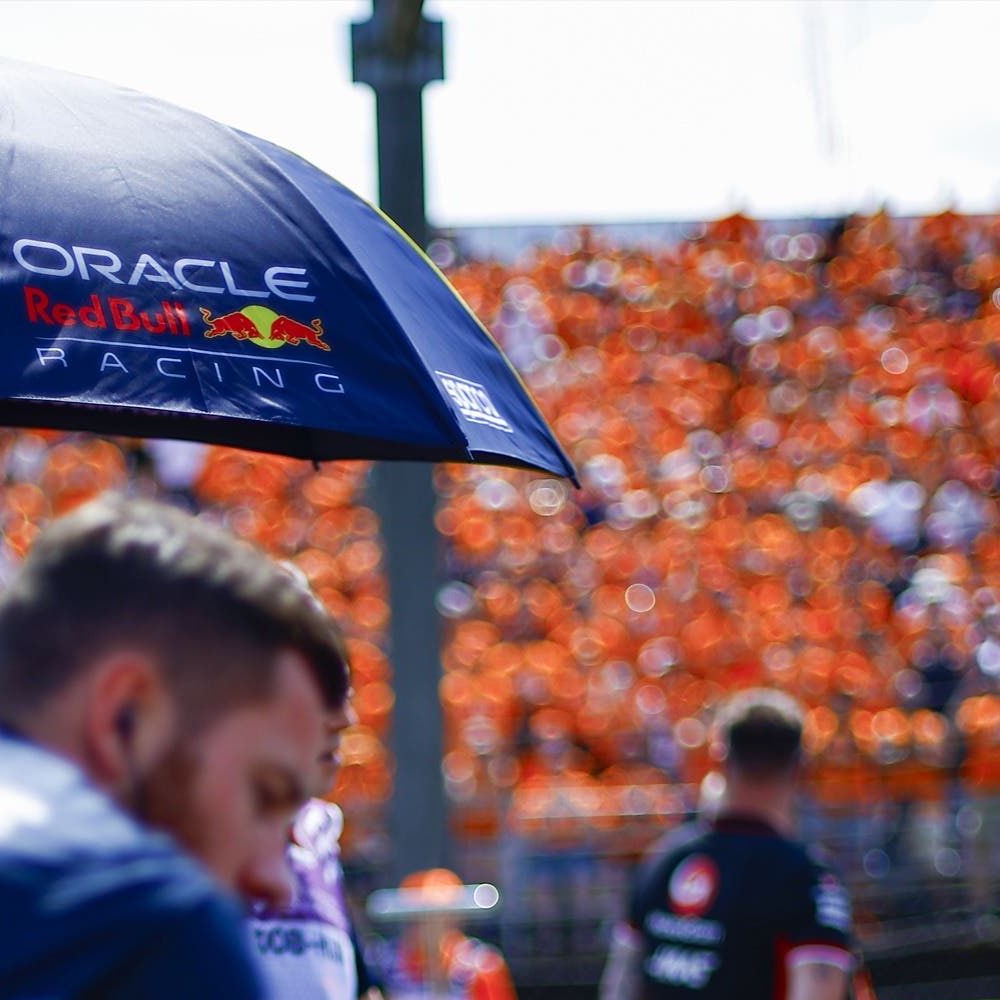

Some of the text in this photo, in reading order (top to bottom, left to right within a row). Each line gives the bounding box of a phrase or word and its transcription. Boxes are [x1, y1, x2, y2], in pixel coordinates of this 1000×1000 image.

[12, 238, 317, 303] ORACLE
[23, 286, 192, 336] Red Bull
[35, 347, 345, 394] RACING
